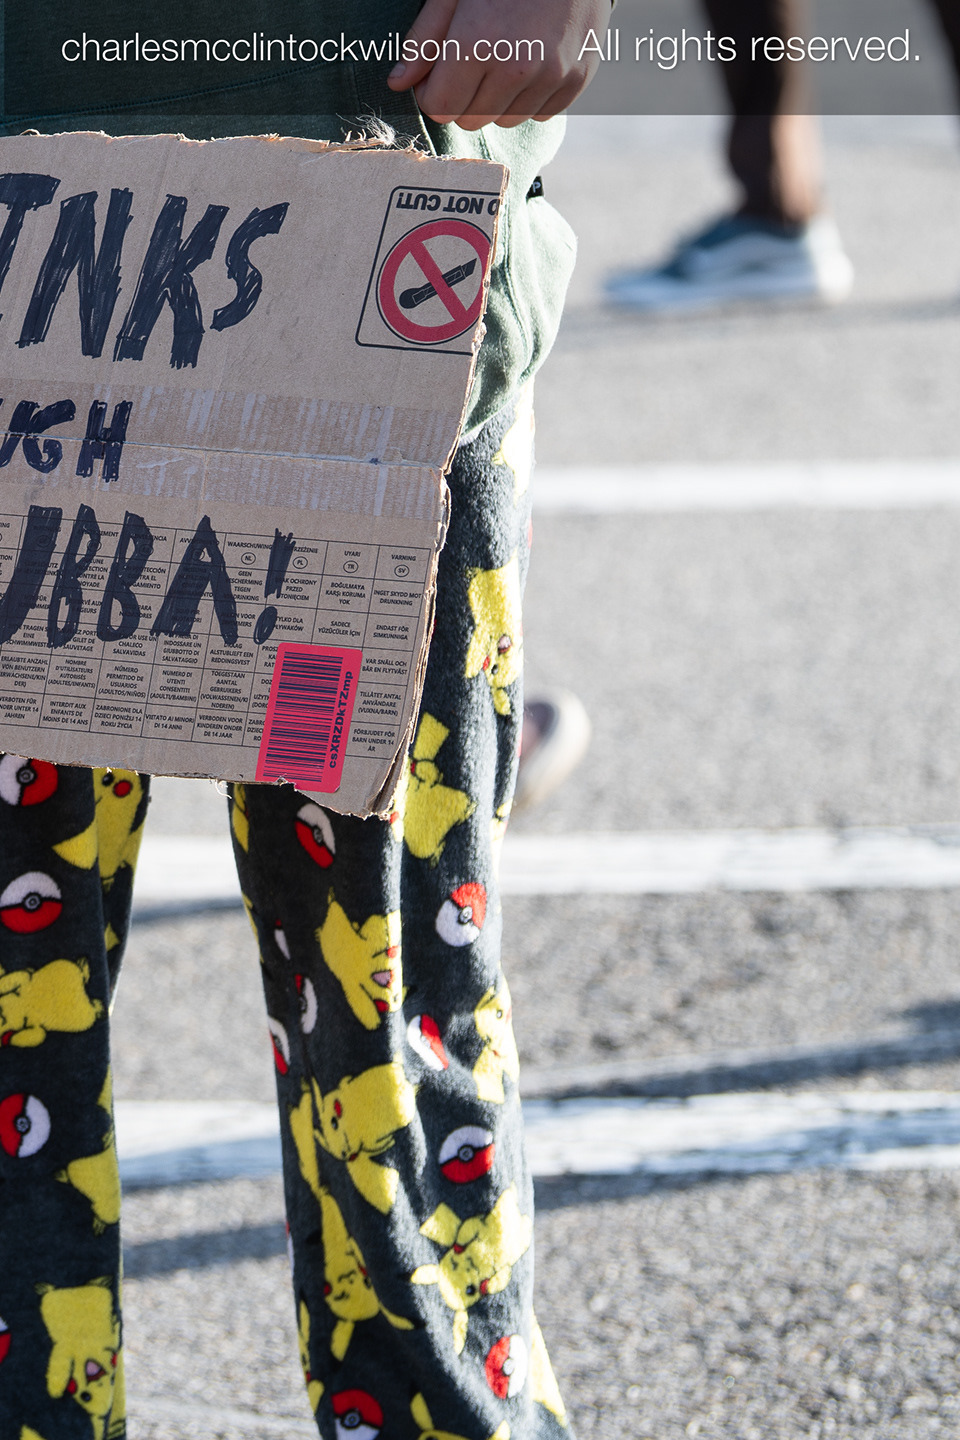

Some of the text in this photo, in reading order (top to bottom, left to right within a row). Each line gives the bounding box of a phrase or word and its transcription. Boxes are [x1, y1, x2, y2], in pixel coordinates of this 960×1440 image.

[396, 192, 441, 211] CUT!
[443, 196, 485, 215] NOT
[226, 540, 272, 550] WAARSCHUWING
[112, 648, 146, 656] SALVAVIDAS
